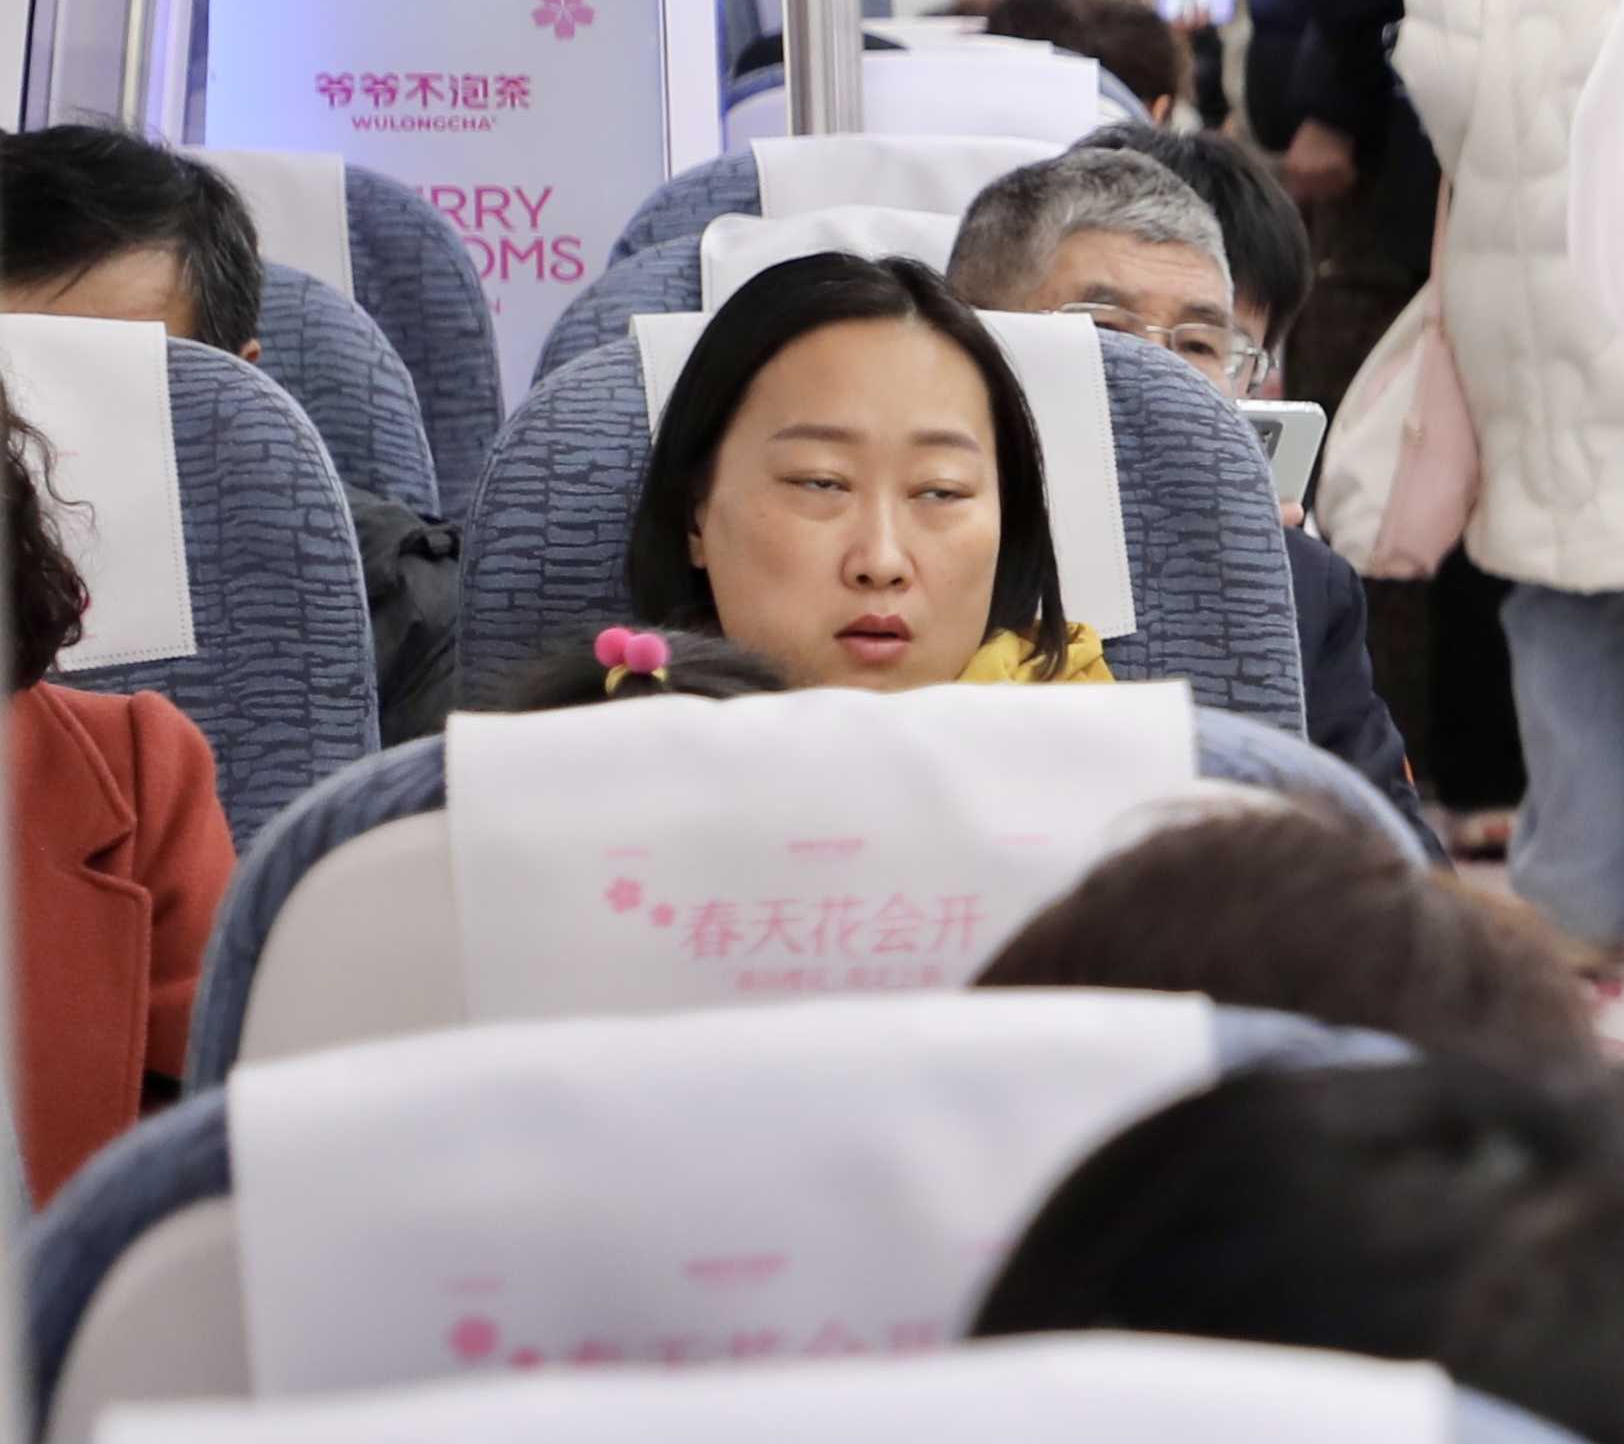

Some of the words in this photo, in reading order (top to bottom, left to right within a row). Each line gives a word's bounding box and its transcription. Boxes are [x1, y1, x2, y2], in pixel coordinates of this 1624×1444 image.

[315, 72, 532, 109] 爷爷不泡茶
[681, 891, 989, 961] 春天花会开
